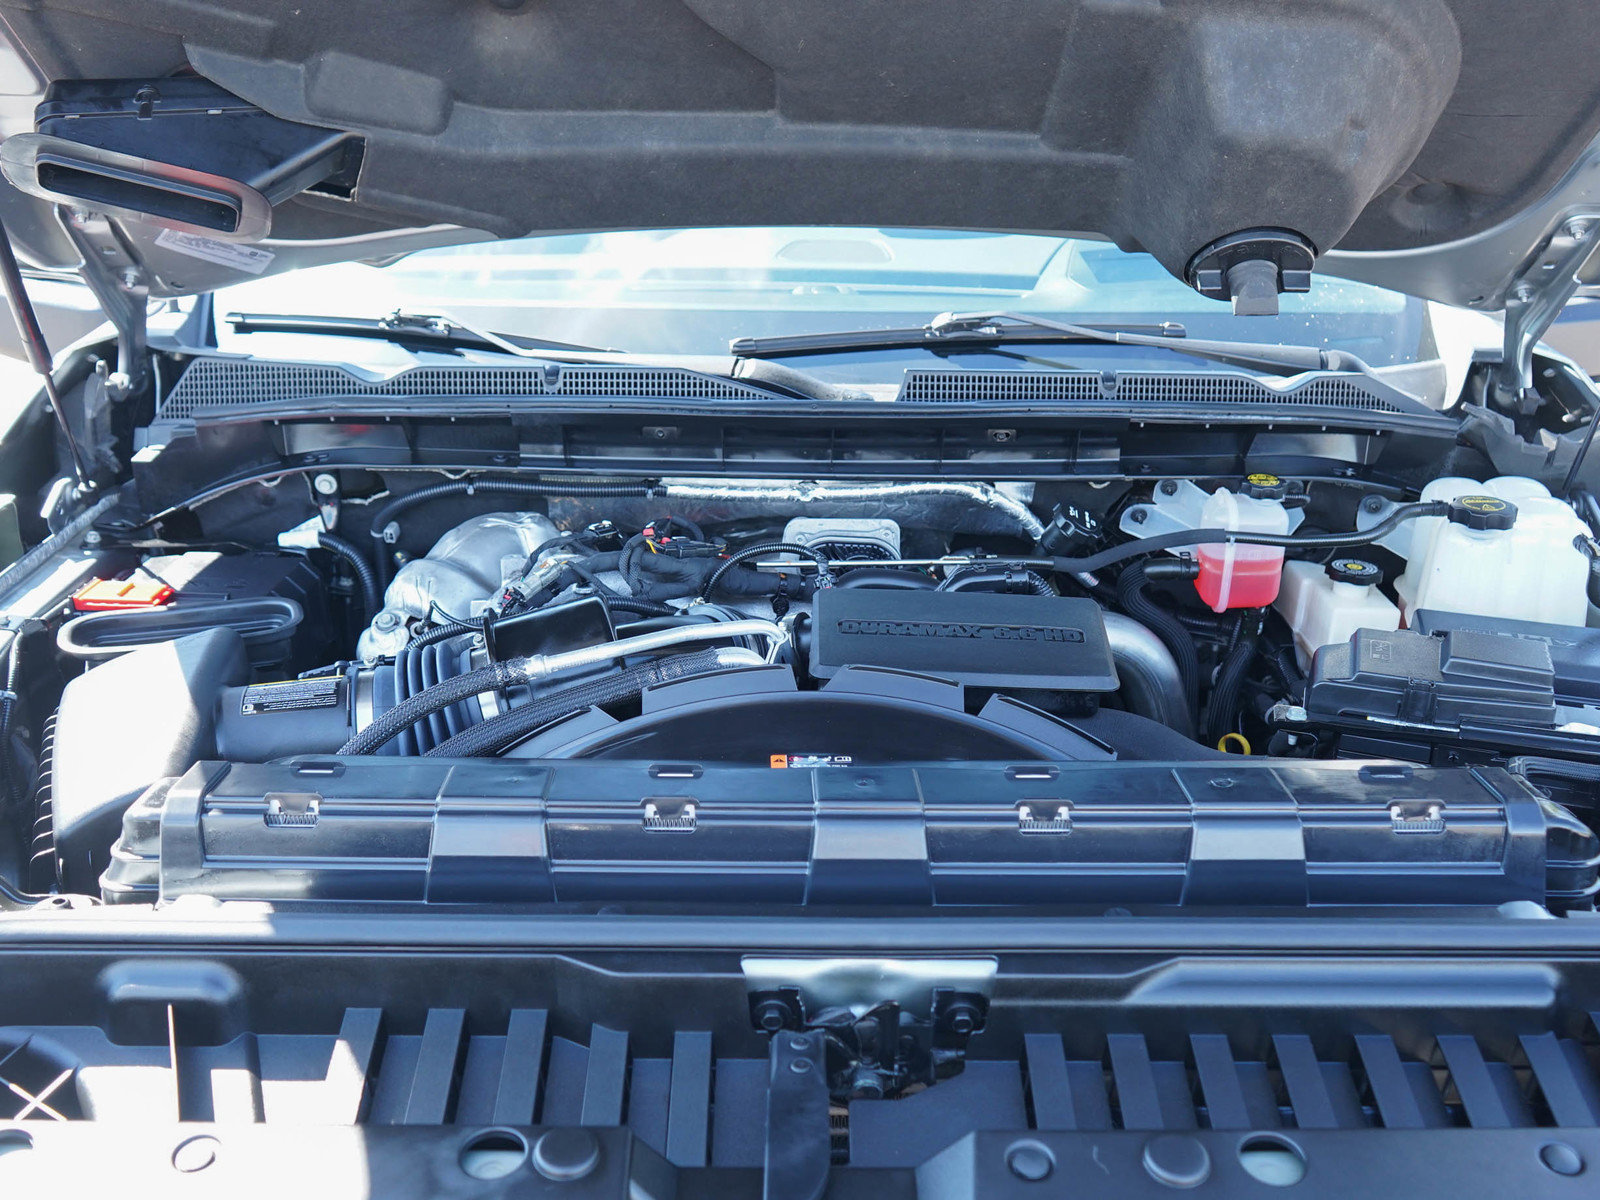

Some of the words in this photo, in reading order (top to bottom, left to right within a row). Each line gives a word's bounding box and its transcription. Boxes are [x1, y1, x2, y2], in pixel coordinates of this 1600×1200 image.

[840, 620, 982, 639] DURAMAX
[993, 626, 1037, 641] 6.6
[1043, 627, 1084, 643] HD
